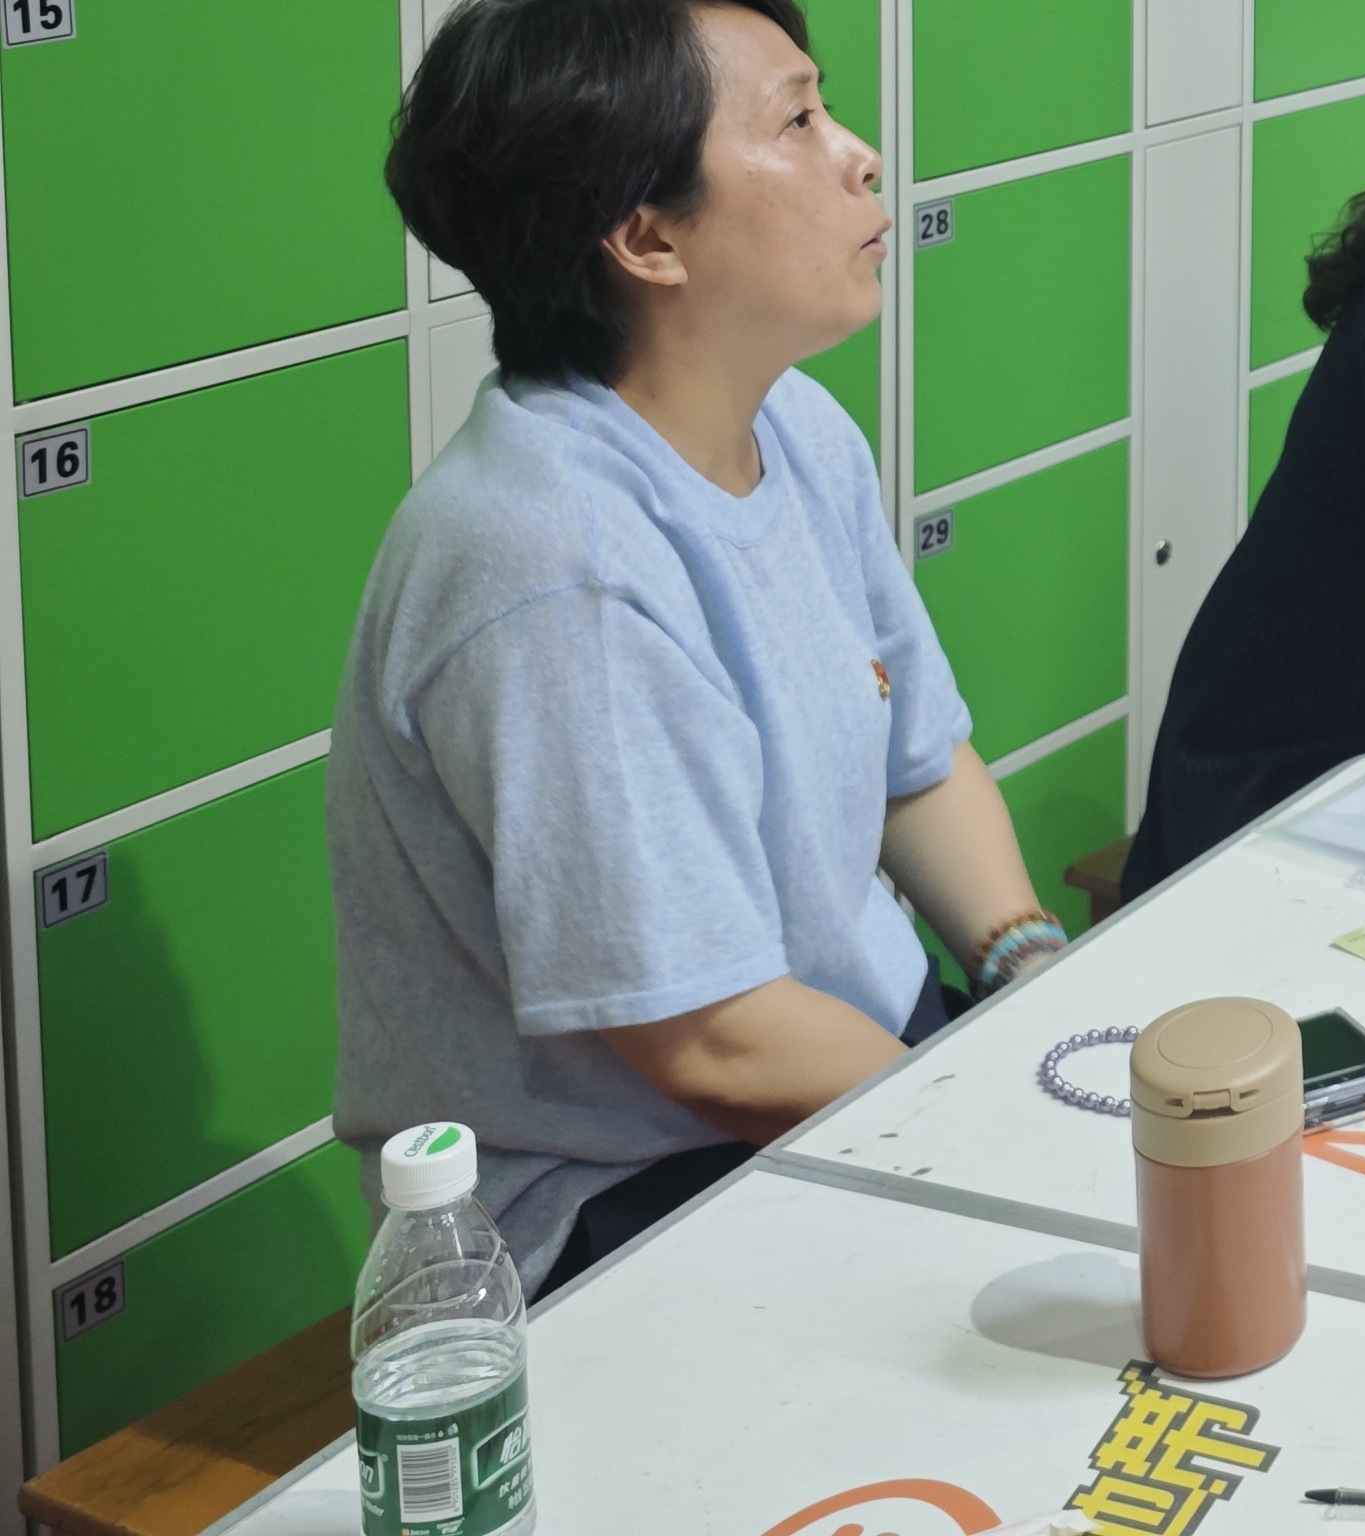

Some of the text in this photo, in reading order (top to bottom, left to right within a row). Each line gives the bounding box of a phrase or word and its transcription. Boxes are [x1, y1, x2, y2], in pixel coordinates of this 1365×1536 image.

[921, 209, 949, 238] 28
[31, 440, 80, 484] 16
[921, 519, 949, 548] 29
[50, 865, 97, 914] 17
[68, 1277, 116, 1327] 18
